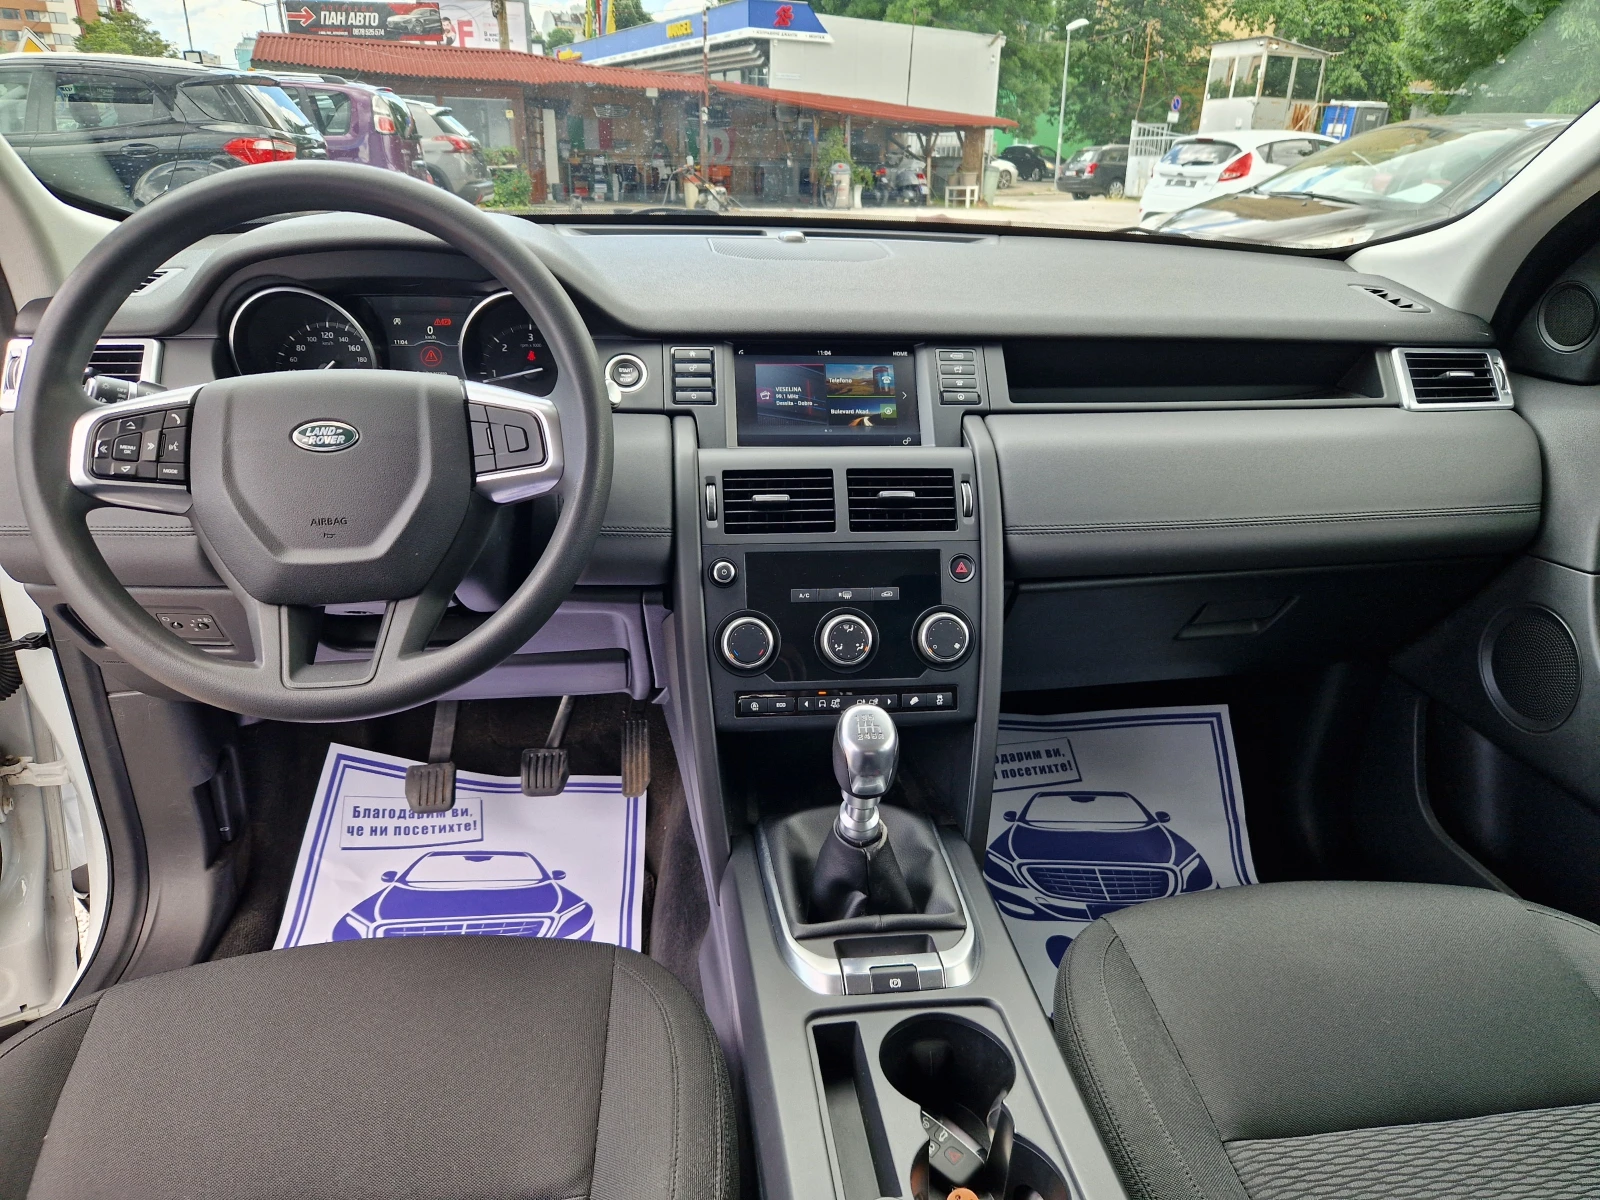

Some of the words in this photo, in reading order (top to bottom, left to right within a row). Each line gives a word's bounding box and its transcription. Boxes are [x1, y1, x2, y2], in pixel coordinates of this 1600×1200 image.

[320, 11, 346, 25] ПАН
[348, 12, 379, 26] АВТО
[365, 28, 375, 36] 525
[320, 331, 334, 339] 120
[426, 325, 434, 335] 0
[527, 333, 534, 342] 3
[295, 344, 306, 352] 80
[348, 344, 361, 352] 160
[501, 343, 508, 352] 2
[306, 426, 336, 436] LAND
[308, 435, 346, 445] ROVER
[310, 517, 348, 527] AIRBAG
[995, 749, 1042, 765] одарим
[1045, 747, 1065, 758] ви,
[1001, 760, 1073, 779] посетихте!
[352, 805, 446, 820] Благодарим
[452, 807, 473, 818] ви,
[347, 825, 364, 837] че
[370, 825, 388, 836] ни
[393, 820, 477, 836] посетихте!
